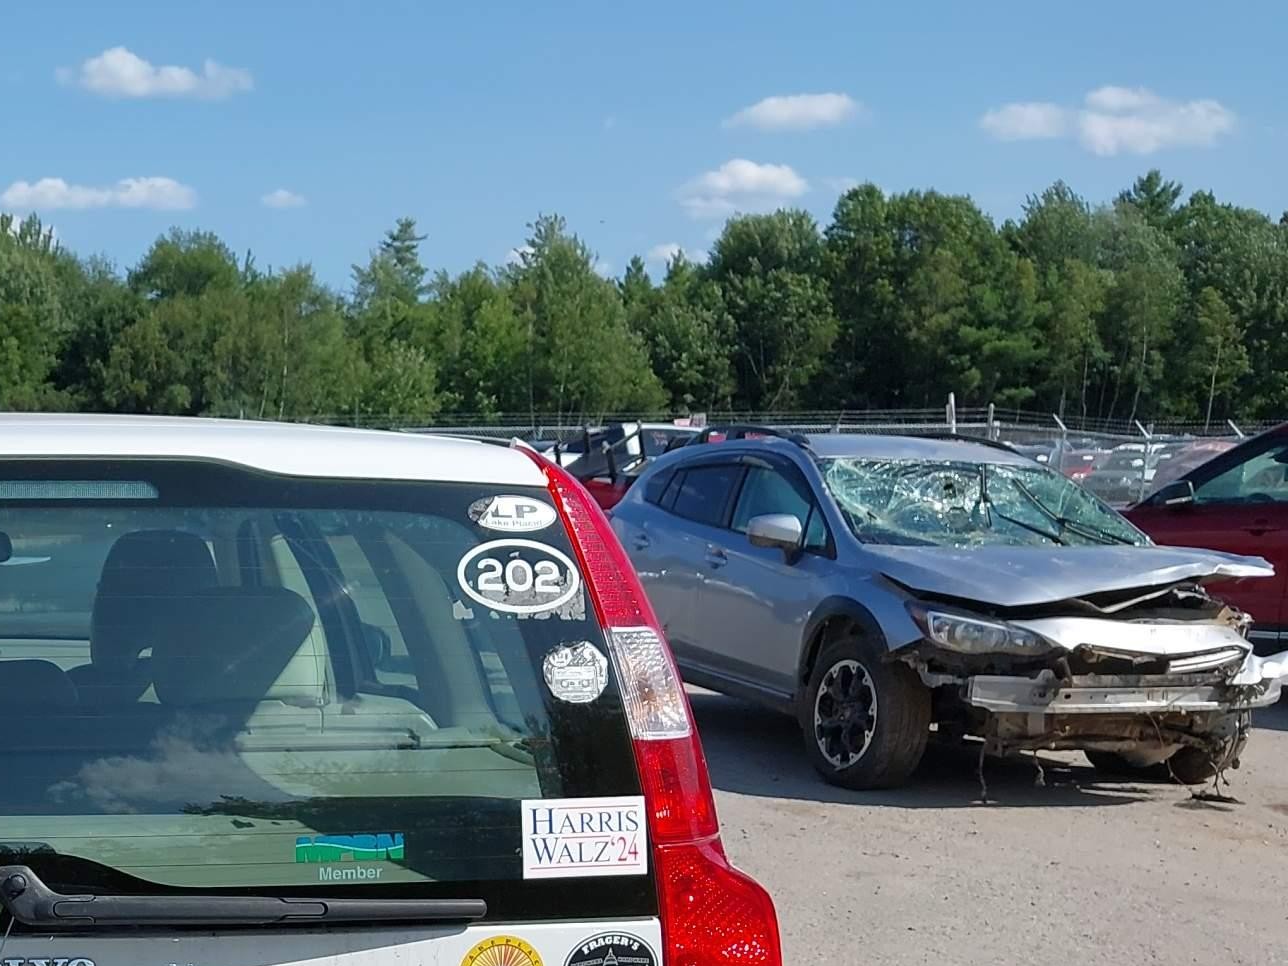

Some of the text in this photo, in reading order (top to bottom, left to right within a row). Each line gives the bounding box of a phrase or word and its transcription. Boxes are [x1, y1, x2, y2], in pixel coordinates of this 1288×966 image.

[477, 558, 561, 592] 202
[530, 807, 639, 835] HARRIS
[319, 866, 383, 881] Member
[581, 935, 641, 955] FRAGER'S
